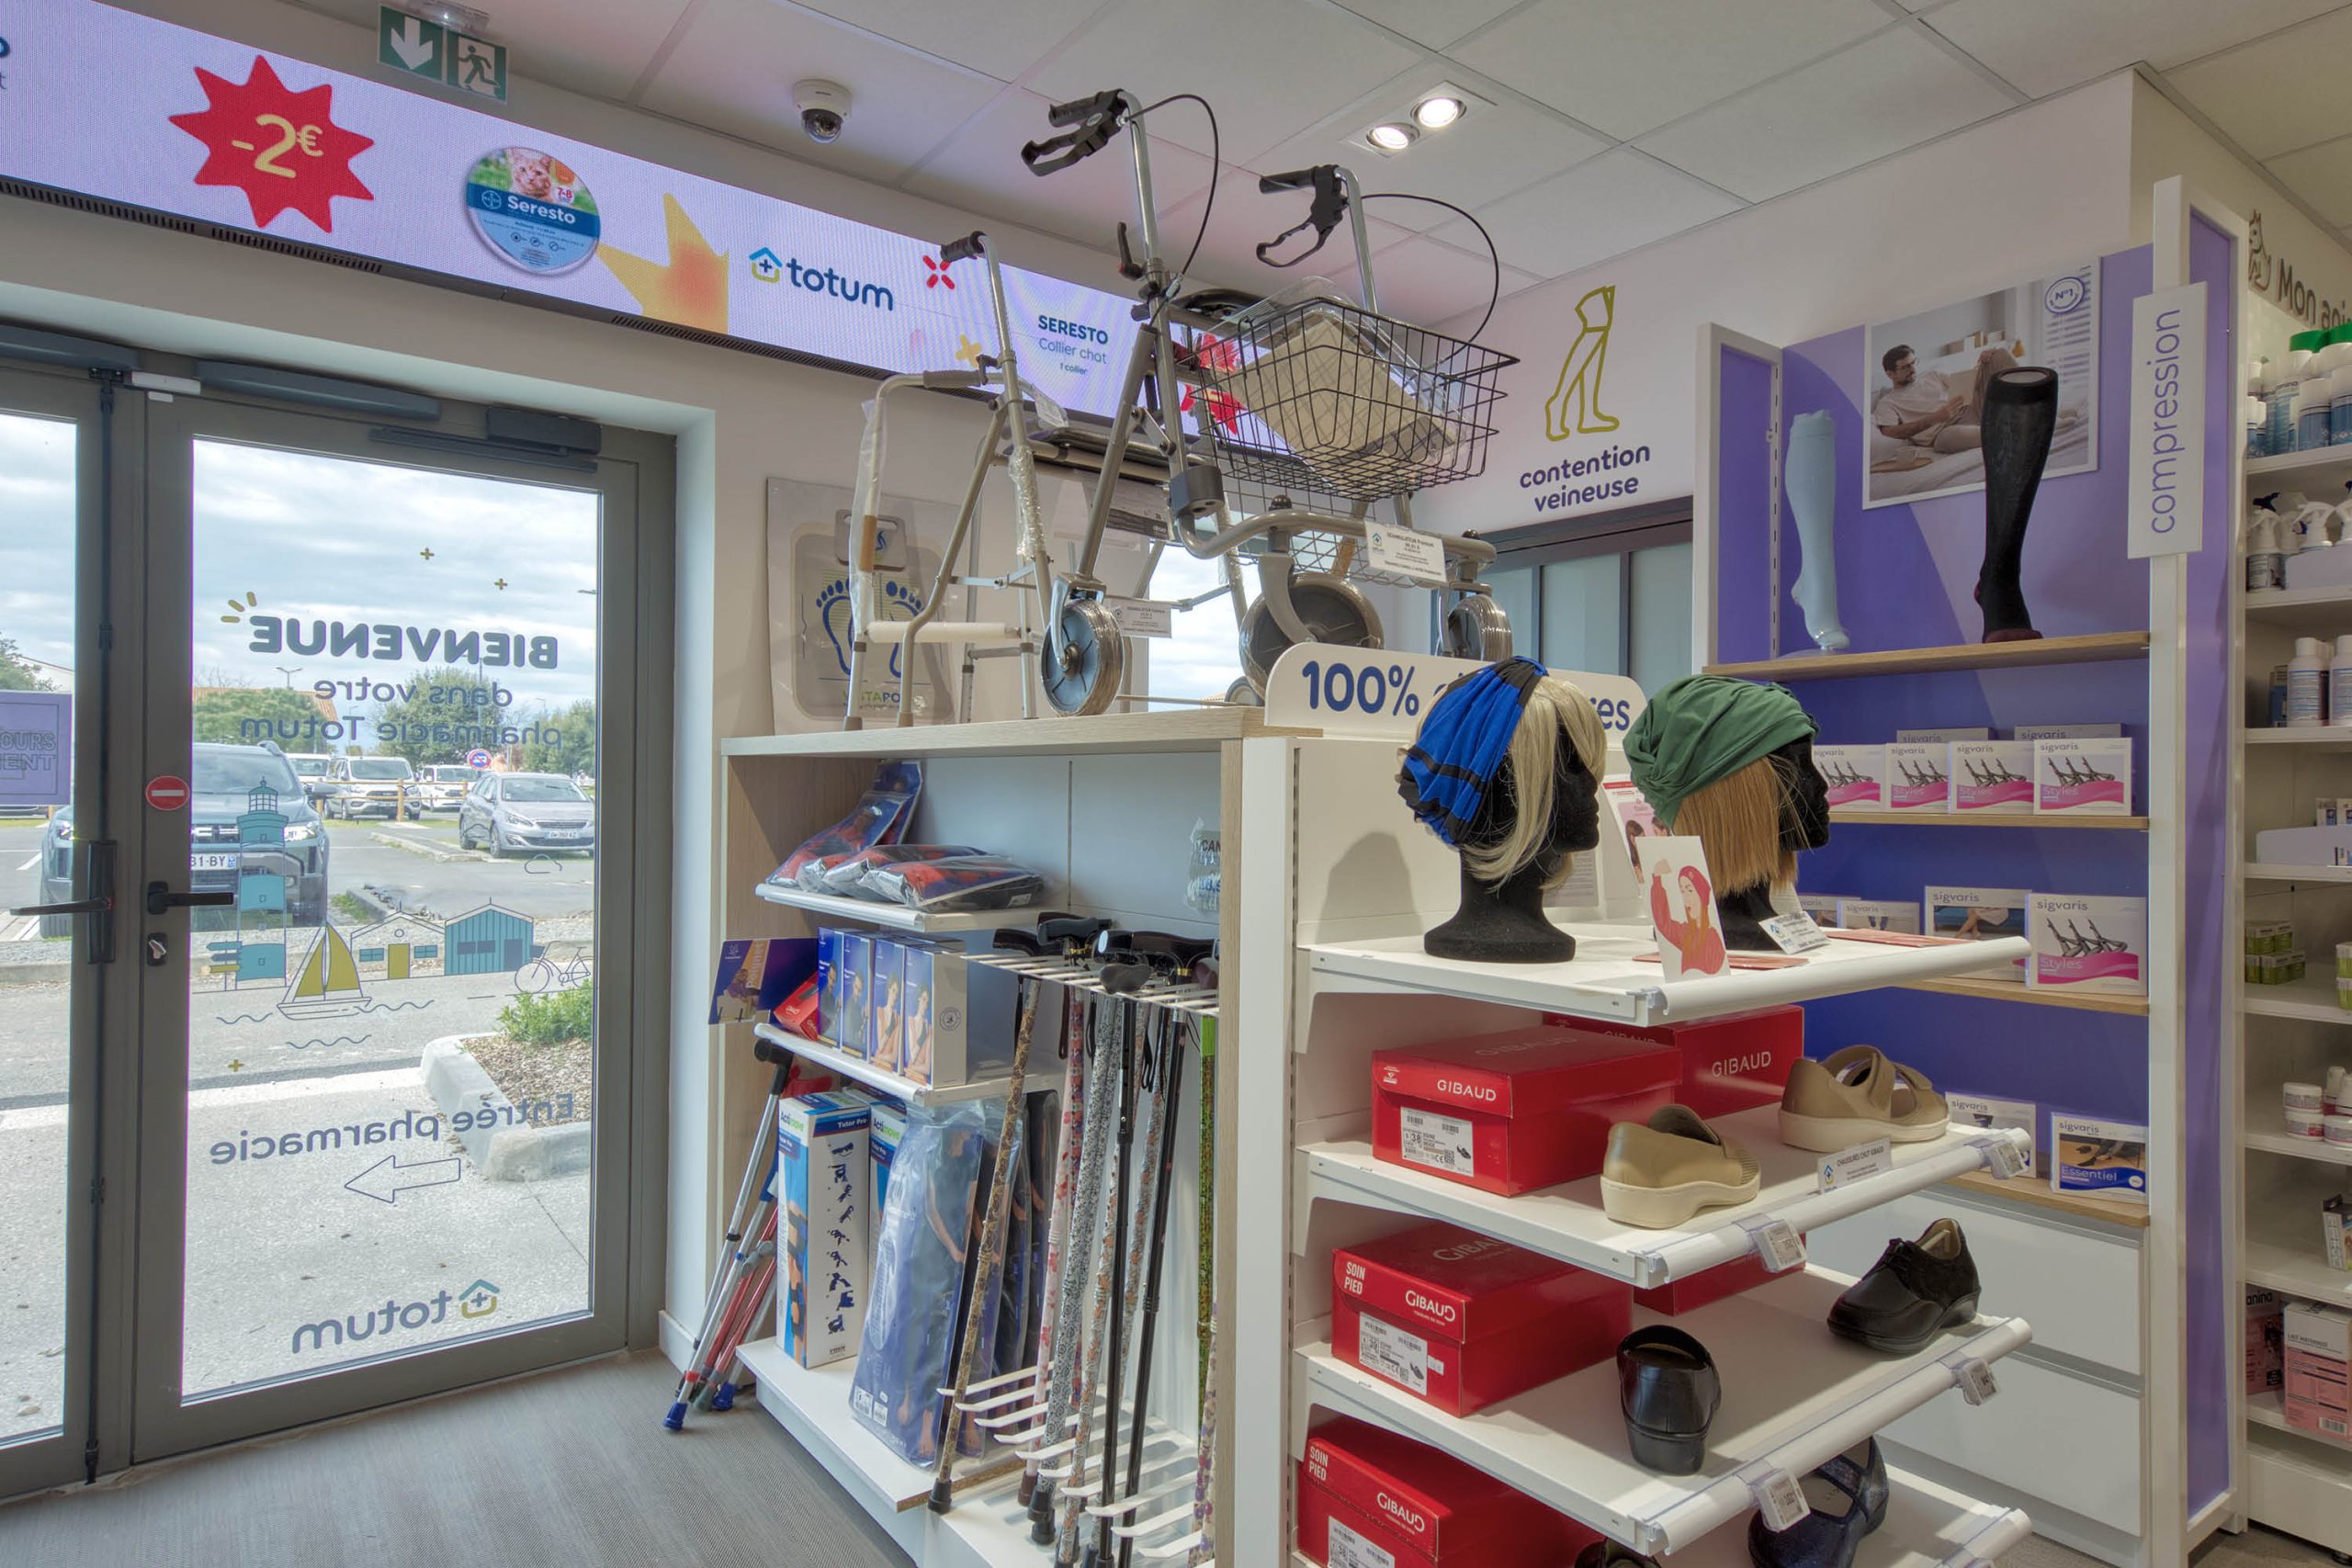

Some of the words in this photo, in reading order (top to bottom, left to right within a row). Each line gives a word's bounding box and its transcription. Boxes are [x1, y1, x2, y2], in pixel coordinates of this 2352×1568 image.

[507, 195, 577, 225] Seresto
[786, 257, 894, 311] totum
[2278, 257, 2316, 326] Mon
[1037, 314, 1109, 345] SERESTO
[1038, 337, 1077, 356] Collier
[1079, 347, 1107, 365] chat
[2147, 307, 2187, 535] compression
[1519, 443, 1651, 491] contention
[1533, 473, 1639, 513] veineuse
[1302, 660, 1420, 716] 100%
[1891, 746, 1926, 757] sigvaris
[1956, 744, 1994, 755] sigvaris
[2040, 741, 2079, 753] sigvaris
[1933, 891, 1980, 904] sigvaris
[2036, 898, 2088, 913] sigvaris
[1712, 1051, 1772, 1078] GIBAUD
[1436, 1079, 1497, 1102] GIBAUD
[1951, 1100, 1988, 1111] sigvaris
[2059, 1121, 2099, 1133] sigvaris
[2062, 1166, 2117, 1181] Essentiel
[1346, 1261, 1366, 1280] SOIN
[1344, 1276, 1363, 1295] PIED
[1405, 1290, 1456, 1323] GIBAUD
[1310, 1446, 1329, 1468] SOIN
[1308, 1461, 1327, 1482] PIED
[1376, 1492, 1425, 1532] GIBAUD
